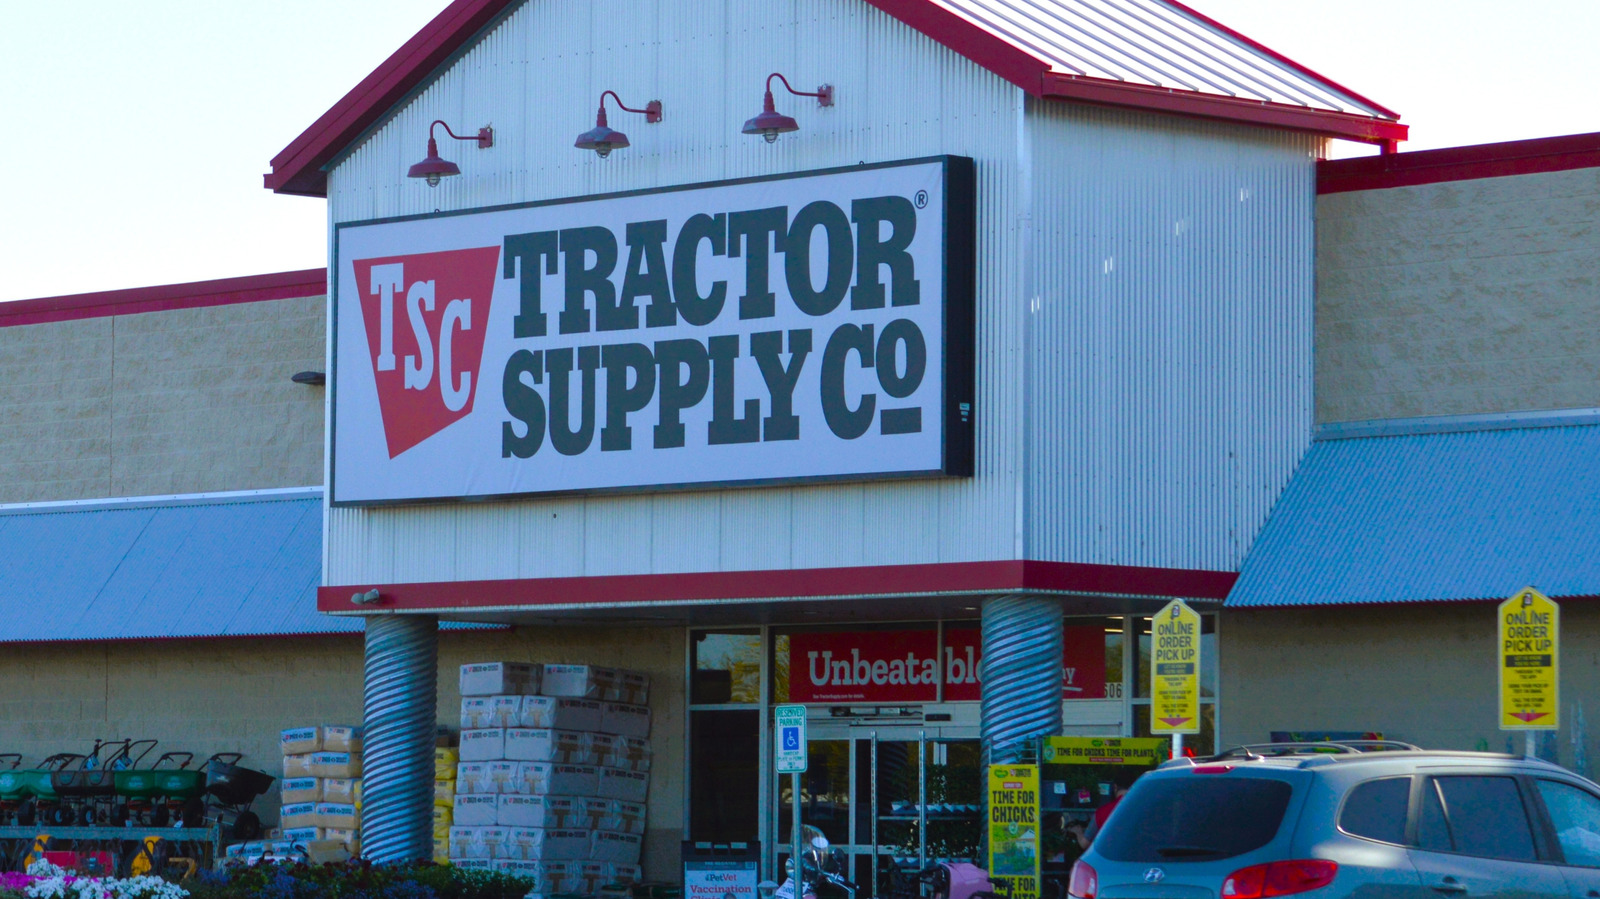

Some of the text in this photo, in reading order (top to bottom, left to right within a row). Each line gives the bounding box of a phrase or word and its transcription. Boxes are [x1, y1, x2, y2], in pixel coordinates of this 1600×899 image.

[503, 195, 920, 338] TRACTOR
[370, 262, 472, 413] TSC
[501, 328, 813, 459] SUPPLY
[1506, 611, 1550, 625] ONLINE
[1158, 622, 1194, 635] ONLINE
[1508, 626, 1548, 638] ORDER
[1159, 636, 1191, 648] ORDER
[1505, 639, 1552, 652] PICK UP
[1156, 648, 1195, 661] PICK UP
[777, 709, 804, 717] RESERVED
[779, 718, 803, 726] PARKING
[1057, 748, 1071, 756] TIME
[1072, 748, 1083, 756] FOR
[1084, 748, 1105, 757] CHICKS
[1107, 748, 1120, 757] TIME
[1122, 748, 1132, 757] FOR
[992, 791, 1035, 804] TIME FOR
[992, 806, 1035, 823] CHICKS
[709, 873, 737, 881] PetVet
[690, 884, 752, 894] Vaccination
[1018, 877, 1035, 891] FOR
